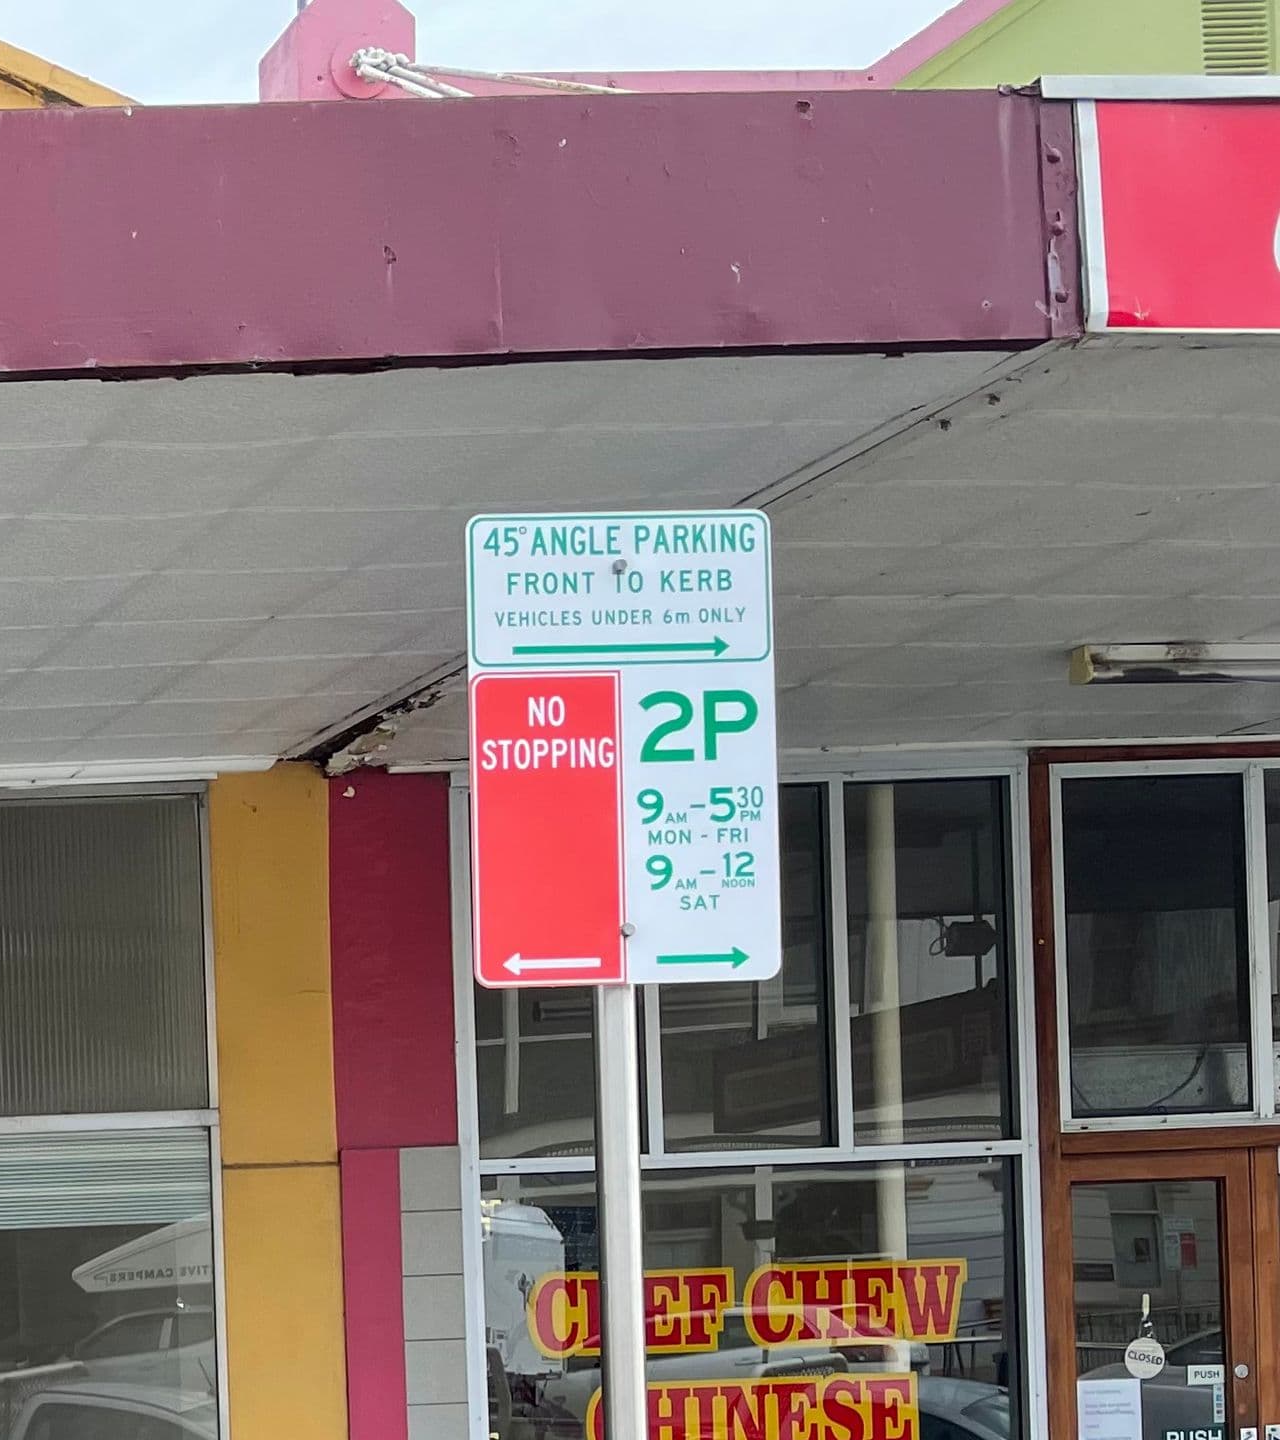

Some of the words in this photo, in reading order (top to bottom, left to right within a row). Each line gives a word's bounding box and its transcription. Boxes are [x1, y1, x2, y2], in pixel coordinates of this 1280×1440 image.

[531, 525, 622, 556] ANGLE
[634, 522, 756, 554] PARKING
[507, 571, 595, 596] FRONT
[614, 569, 644, 594] TO
[660, 568, 733, 592] KERB
[495, 610, 582, 627] VEHICLES
[592, 609, 652, 625] UNDER
[663, 607, 690, 624] 6m
[699, 606, 746, 623] ONLY
[527, 696, 566, 727] NO
[638, 690, 759, 763] 2P
[481, 737, 615, 771] STOPPING
[648, 829, 692, 845] MON
[717, 827, 749, 844] FRI
[680, 894, 720, 911] SAT
[746, 1258, 967, 1349] CHEW
[1127, 1350, 1163, 1366] CLOSED
[1193, 1370, 1220, 1379] PUSH
